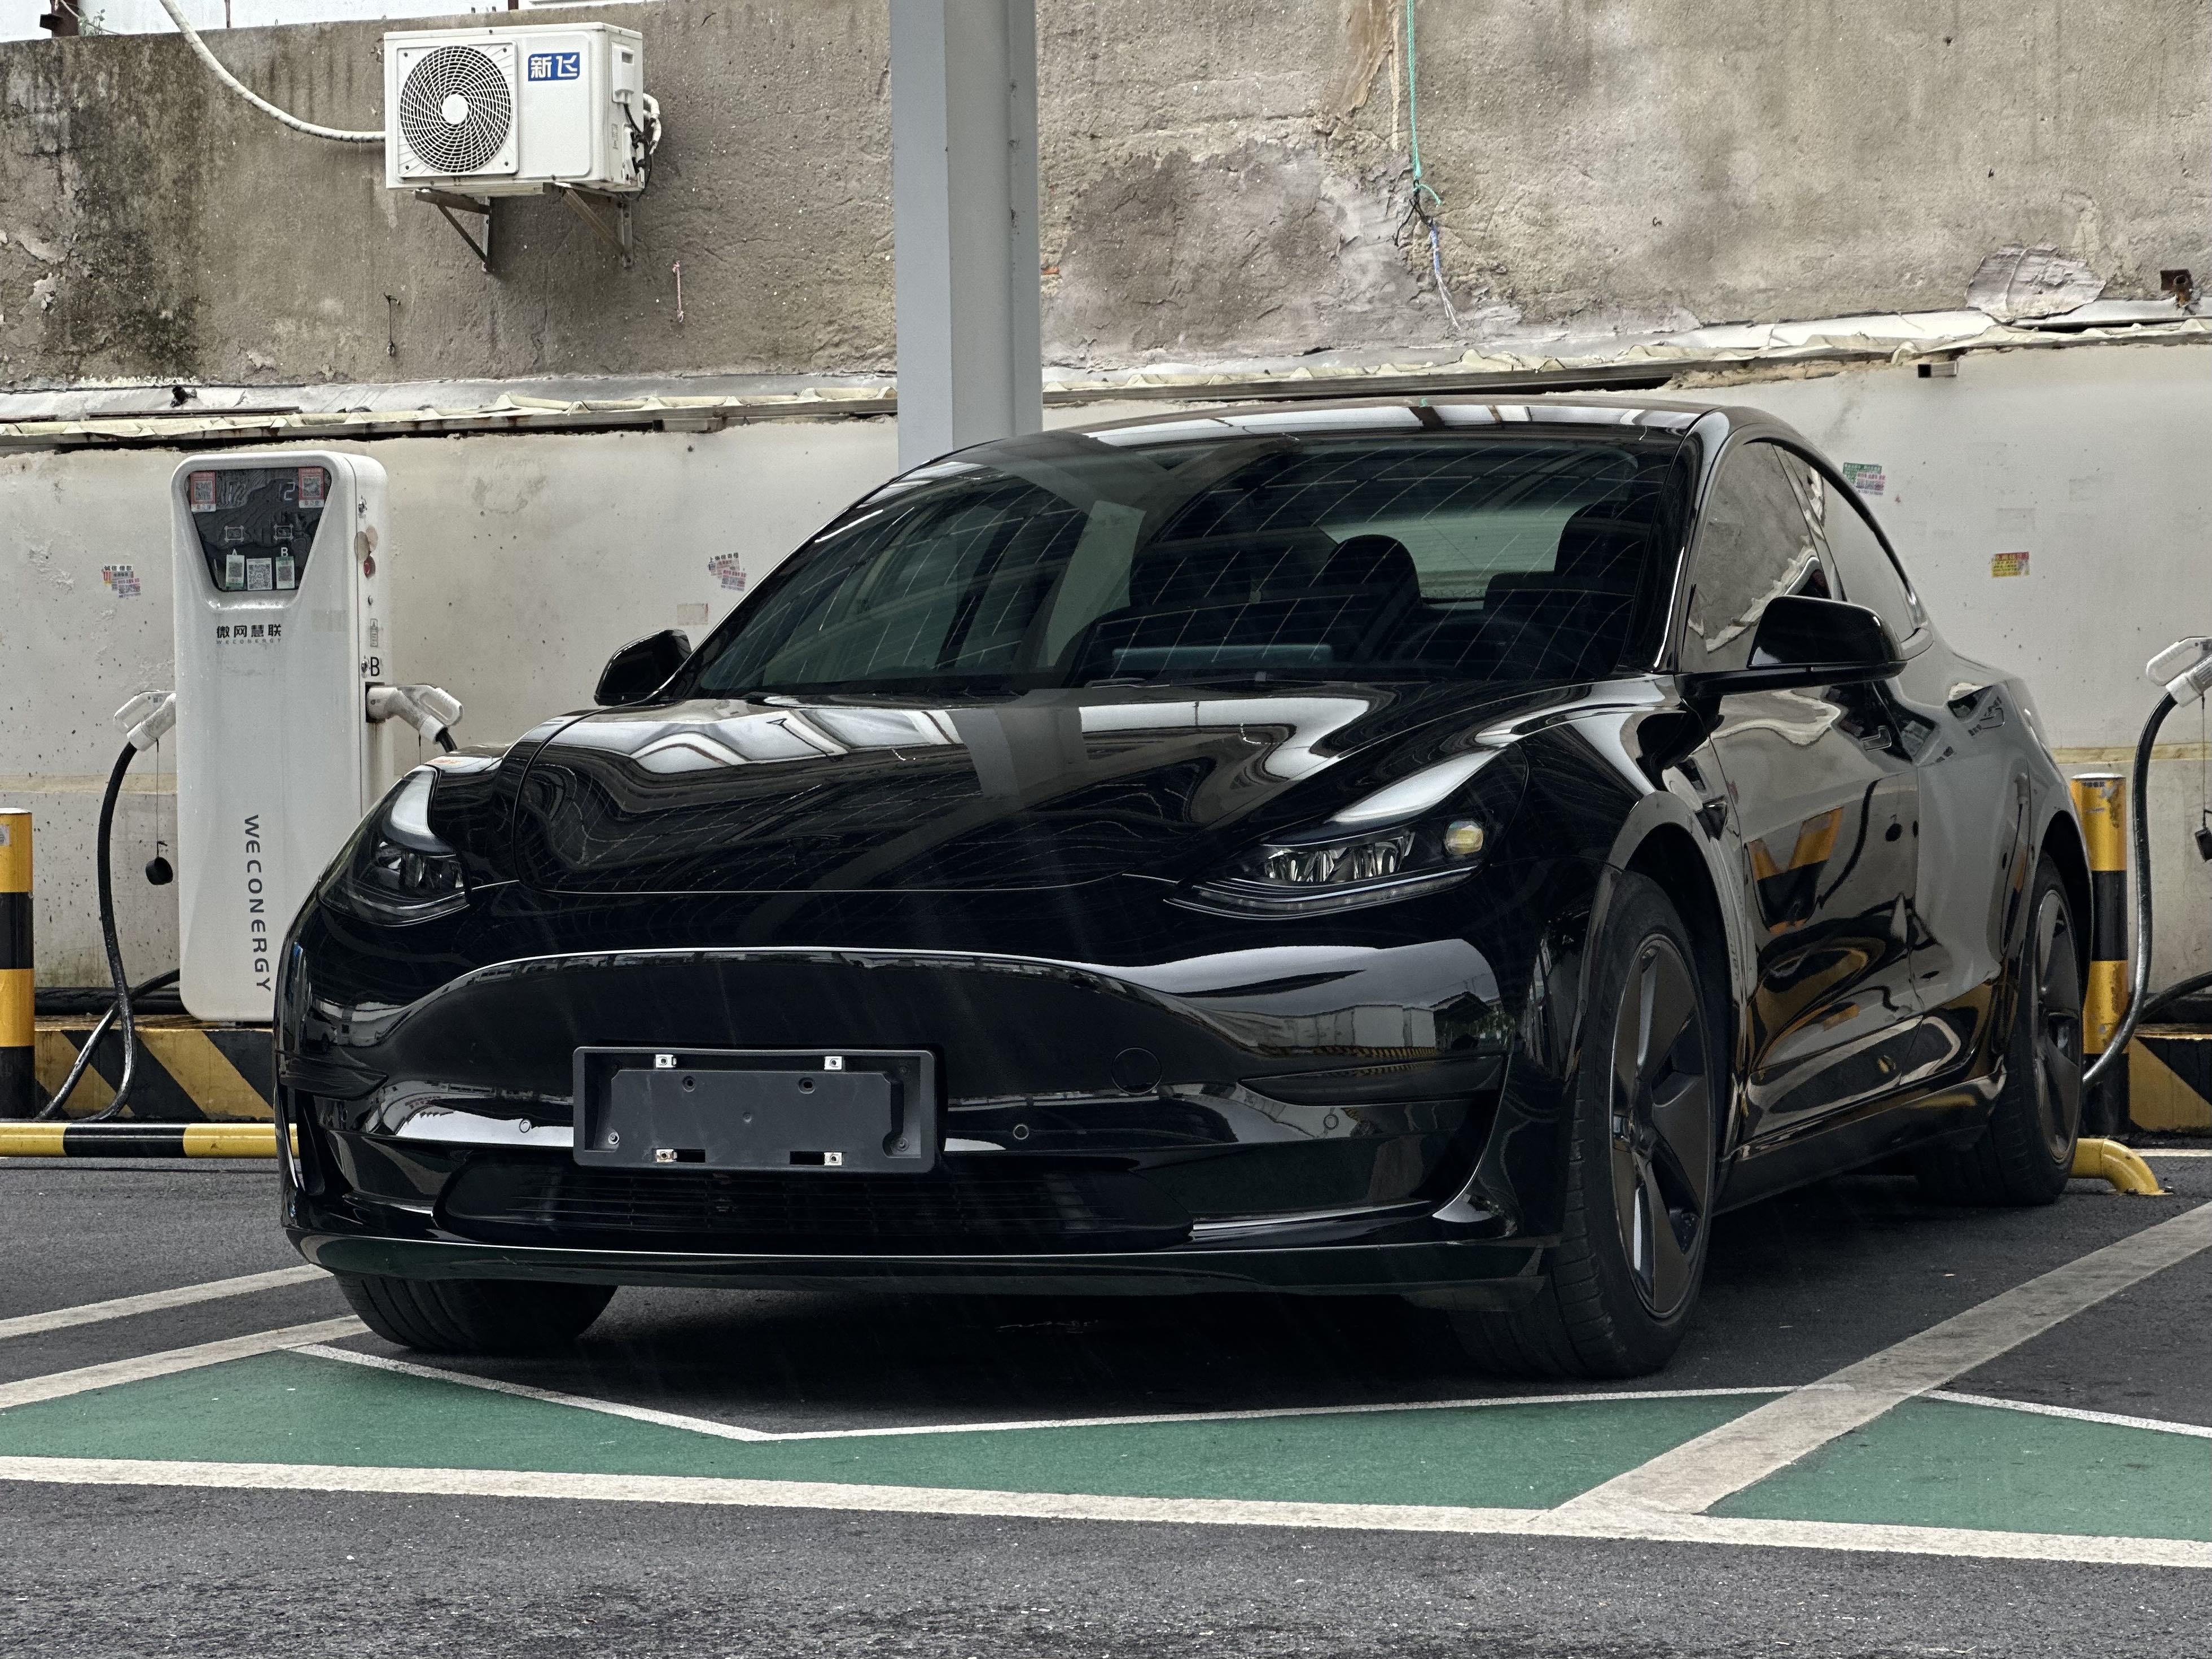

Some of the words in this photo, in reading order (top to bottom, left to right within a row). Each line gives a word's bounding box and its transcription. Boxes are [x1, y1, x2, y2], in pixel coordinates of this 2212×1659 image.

[531, 55, 577, 78] 新飞
[281, 546, 288, 557] B
[216, 624, 281, 638] 微网慧联
[370, 656, 380, 677] B
[244, 814, 271, 992] WECONERGY
